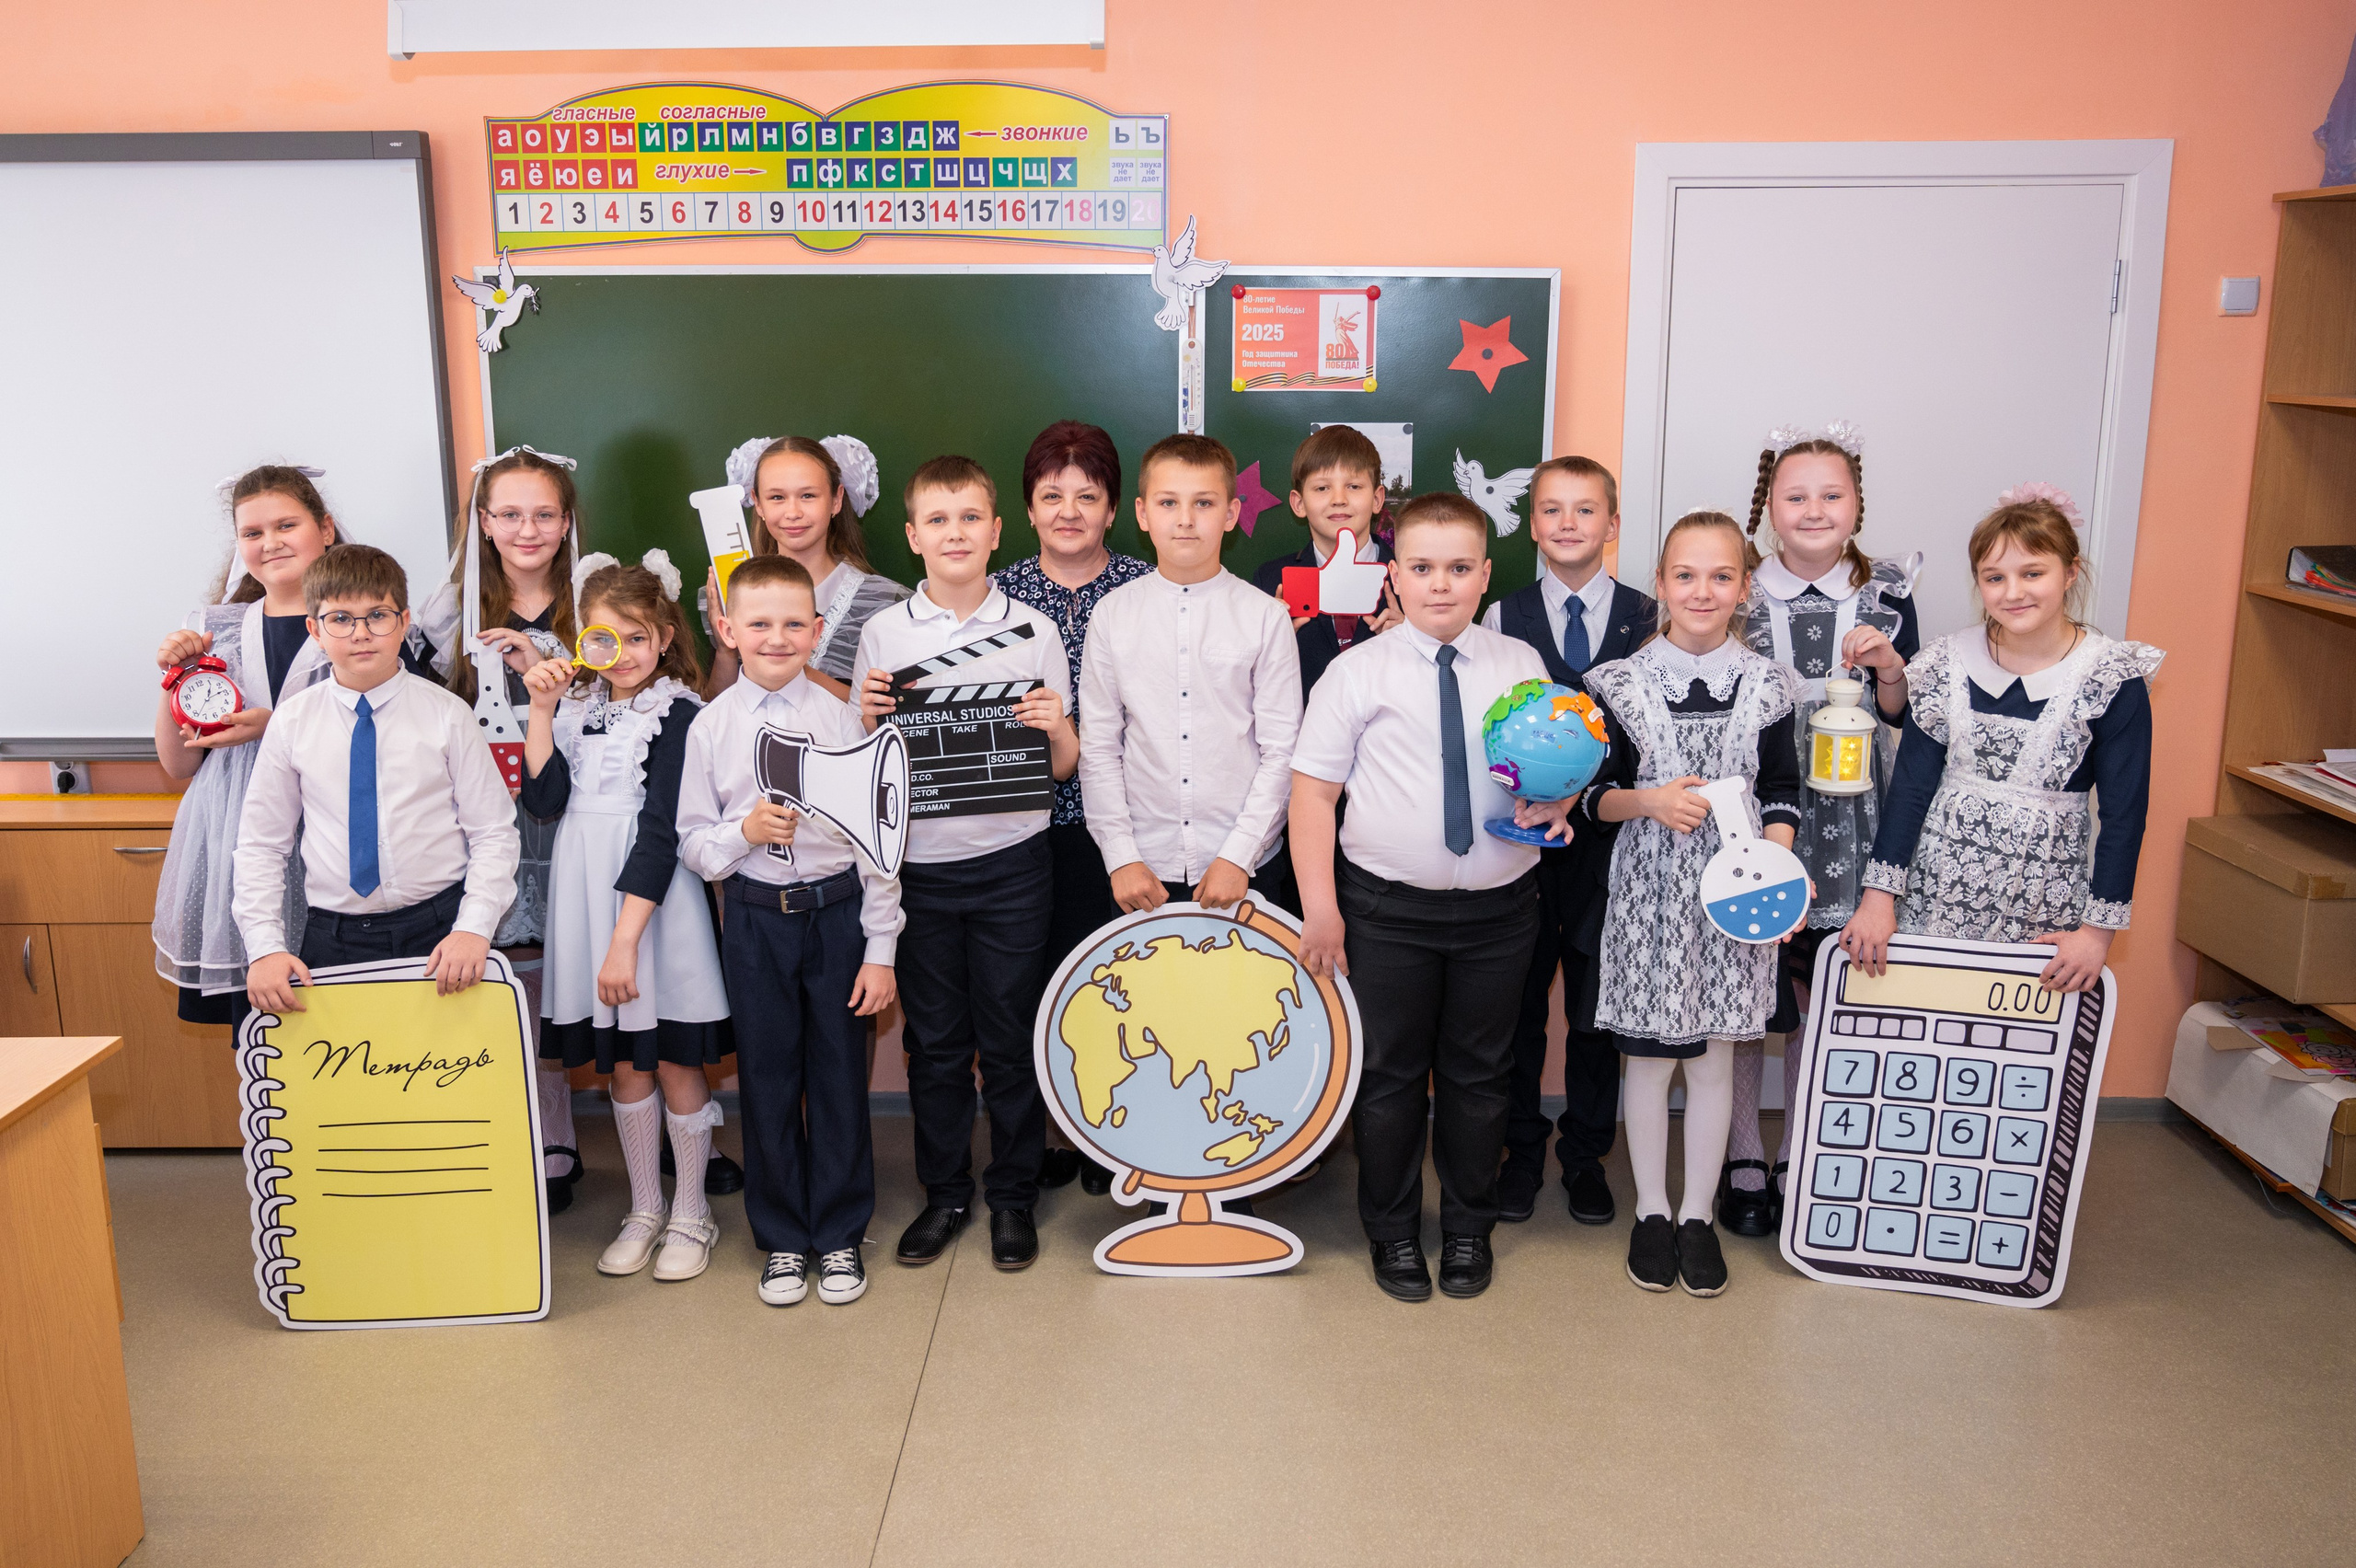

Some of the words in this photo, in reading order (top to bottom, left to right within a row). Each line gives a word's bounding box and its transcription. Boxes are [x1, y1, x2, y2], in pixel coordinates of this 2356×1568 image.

[552, 108, 635, 121] гласные
[660, 106, 767, 120] согласные
[498, 129, 512, 146] а
[525, 129, 541, 146] о
[556, 129, 571, 152] у
[584, 128, 599, 146] э
[611, 128, 633, 146] ы
[645, 122, 661, 146] й
[673, 128, 687, 151] р
[703, 128, 720, 145] л
[732, 128, 750, 145] м
[763, 128, 778, 145] н
[791, 121, 808, 145] б
[822, 128, 837, 145] в
[853, 127, 864, 144] г
[881, 127, 895, 144] з
[907, 127, 926, 149] д
[936, 127, 956, 144] ж
[1000, 126, 1088, 141] звонкие
[1115, 127, 1130, 143] ь
[1141, 127, 1161, 143] ъ
[501, 168, 515, 185] я
[528, 163, 544, 185] ё
[556, 167, 577, 185] ю
[587, 167, 603, 185] е
[617, 167, 632, 185] и
[655, 163, 730, 184] глухие
[793, 165, 807, 182] п
[818, 159, 842, 188] ф
[854, 165, 868, 181] к
[881, 164, 896, 181] с
[910, 164, 924, 180] т
[937, 164, 958, 181] ш
[969, 164, 986, 185] ц
[998, 163, 1012, 180] ч
[1024, 163, 1046, 184] щ
[1057, 163, 1072, 180] х
[509, 202, 519, 224] 1
[539, 202, 554, 224] 2
[572, 202, 586, 224] 3
[605, 201, 619, 224] 4
[640, 202, 653, 224] 5
[672, 201, 687, 224] 6
[705, 201, 719, 223] 7
[738, 201, 752, 224] 8
[769, 201, 784, 223] 9
[797, 201, 826, 223] 10
[833, 201, 857, 223] 11
[863, 201, 893, 223] 12
[897, 200, 926, 223] 13
[930, 200, 958, 223] 14
[964, 199, 992, 223] 15
[998, 199, 1026, 223] 16
[1031, 199, 1059, 223] 17
[1064, 199, 1092, 223] 18
[1097, 199, 1126, 223] 19
[1132, 199, 1161, 223] 20
[1243, 295, 1276, 304] 80-летие
[1243, 306, 1274, 314] Великой
[1276, 306, 1305, 315] Победы
[1242, 324, 1285, 342] 2025
[1242, 350, 1253, 359] Год
[1255, 351, 1298, 359] защитника
[1325, 343, 1346, 359] 80
[1325, 361, 1359, 370] ПОБЕДА!
[961, 705, 1014, 721] STUDIOS
[902, 729, 930, 738] CENE
[952, 725, 977, 734] TAKE
[990, 753, 1027, 764] SOUND
[911, 773, 934, 782] D.CO.
[911, 789, 939, 798] ECTOR
[910, 802, 950, 813] MERAMAN
[1988, 982, 2051, 1014] 0.00
[303, 1040, 494, 1092] Тетрадь
[1844, 1060, 1860, 1086] 7
[1895, 1061, 1918, 1091] 8
[1957, 1067, 1981, 1097] 9
[1832, 1107, 1855, 1136] 4
[1894, 1112, 1915, 1137] 5
[1951, 1118, 1974, 1145] 6
[1833, 1166, 1841, 1187] 1
[1888, 1170, 1907, 1194] 2
[1946, 1175, 1962, 1202] 3
[1826, 1211, 1841, 1239] 0
